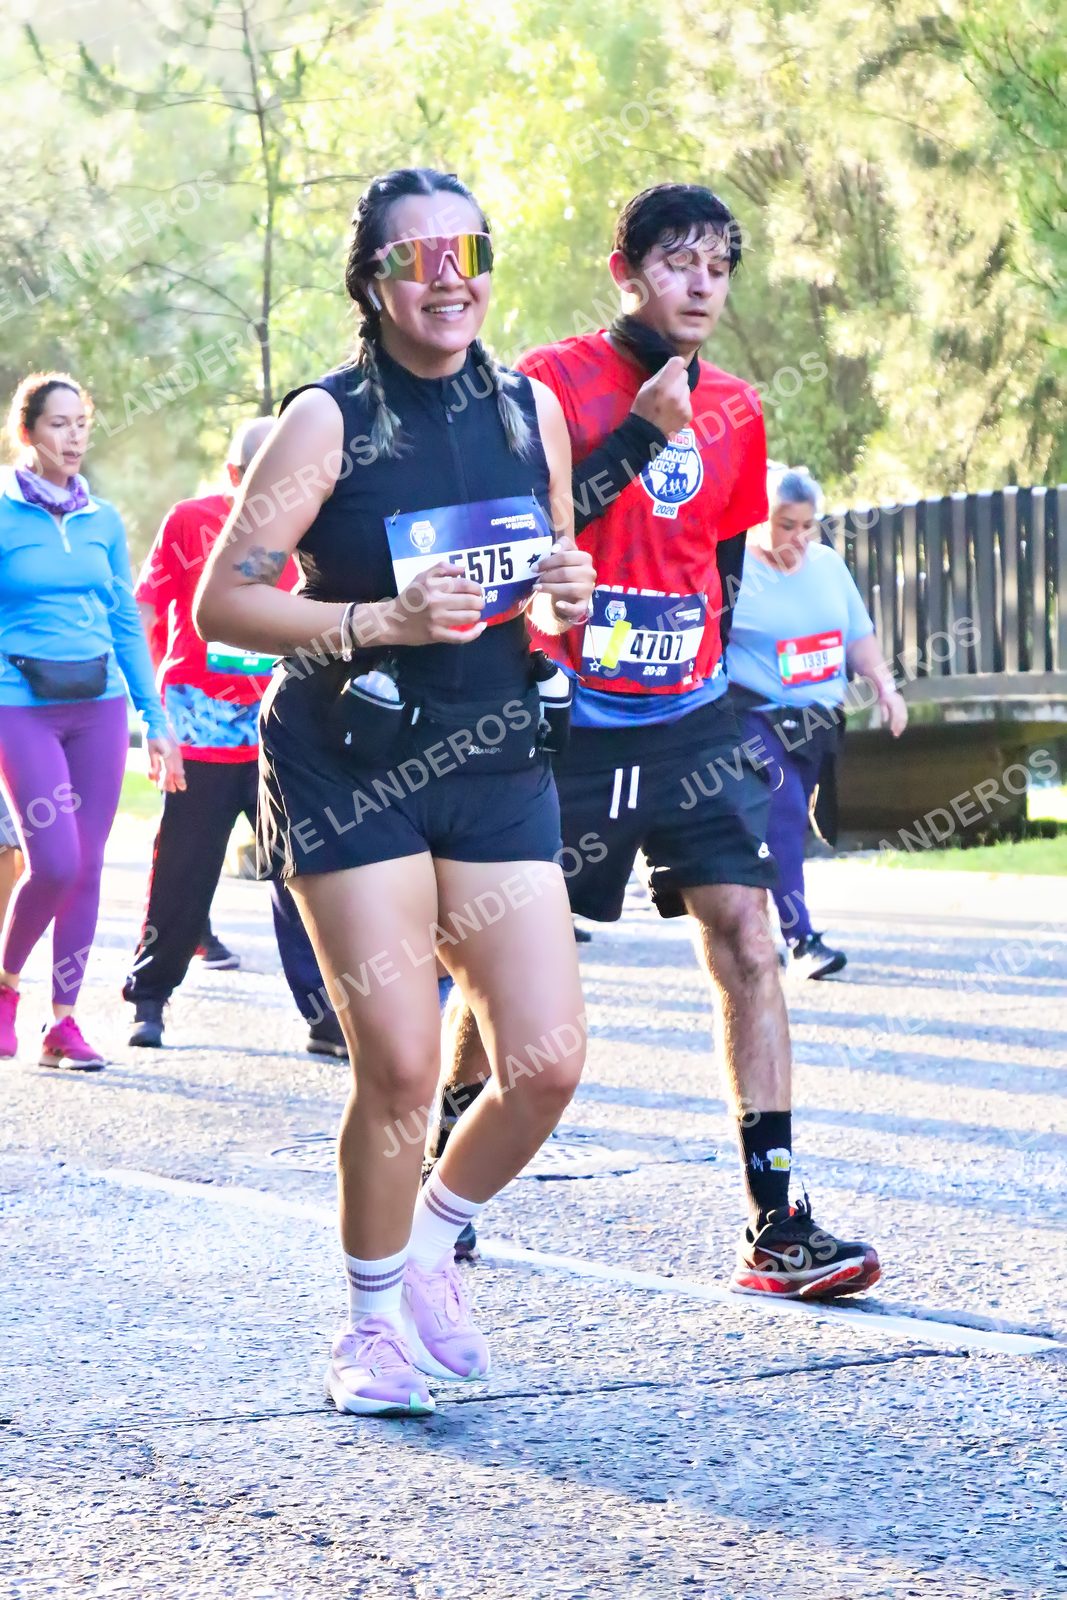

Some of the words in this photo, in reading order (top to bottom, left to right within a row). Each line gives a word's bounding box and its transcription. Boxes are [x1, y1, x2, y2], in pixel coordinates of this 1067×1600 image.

[655, 504, 676, 516] 2026
[481, 590, 498, 603] -26
[630, 632, 683, 660] 4707
[642, 665, 668, 676] 20-26
